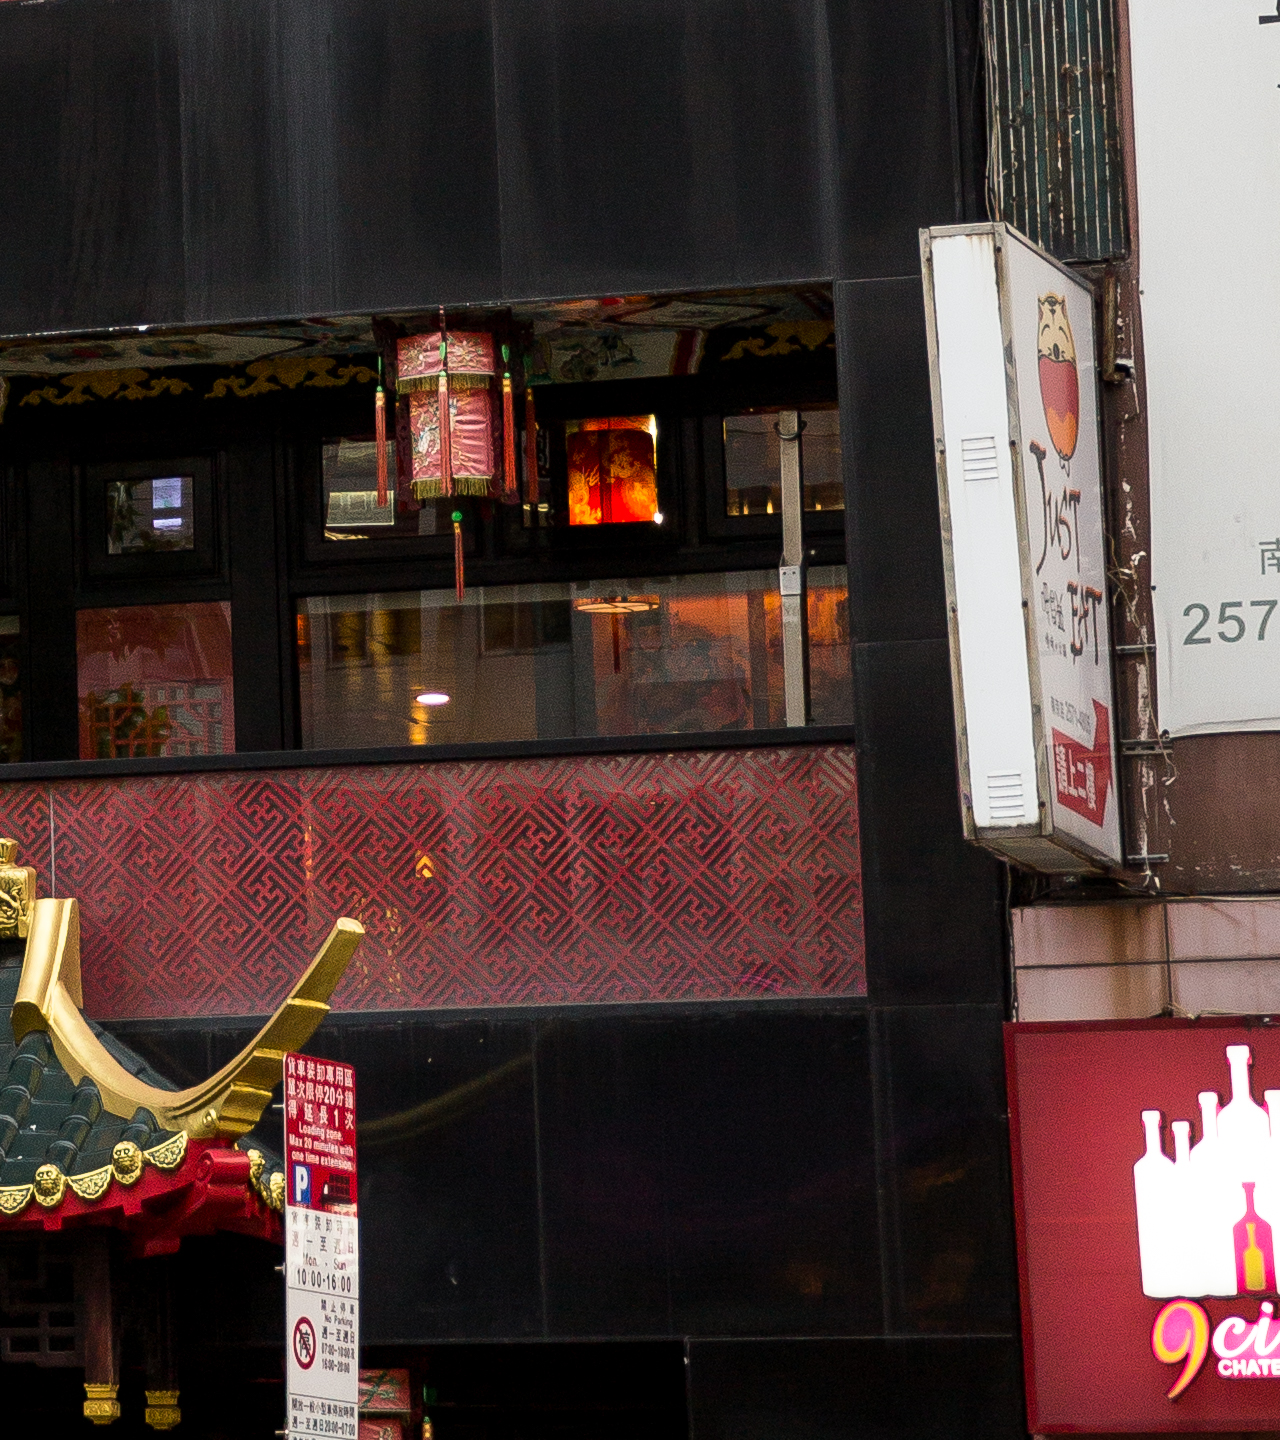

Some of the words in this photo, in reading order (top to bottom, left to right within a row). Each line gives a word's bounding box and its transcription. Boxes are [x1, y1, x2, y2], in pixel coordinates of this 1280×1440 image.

[298, 1121, 325, 1140] Loading
[288, 1133, 303, 1148] Max
[304, 1137, 313, 1150] 20
[295, 1165, 308, 1203] P
